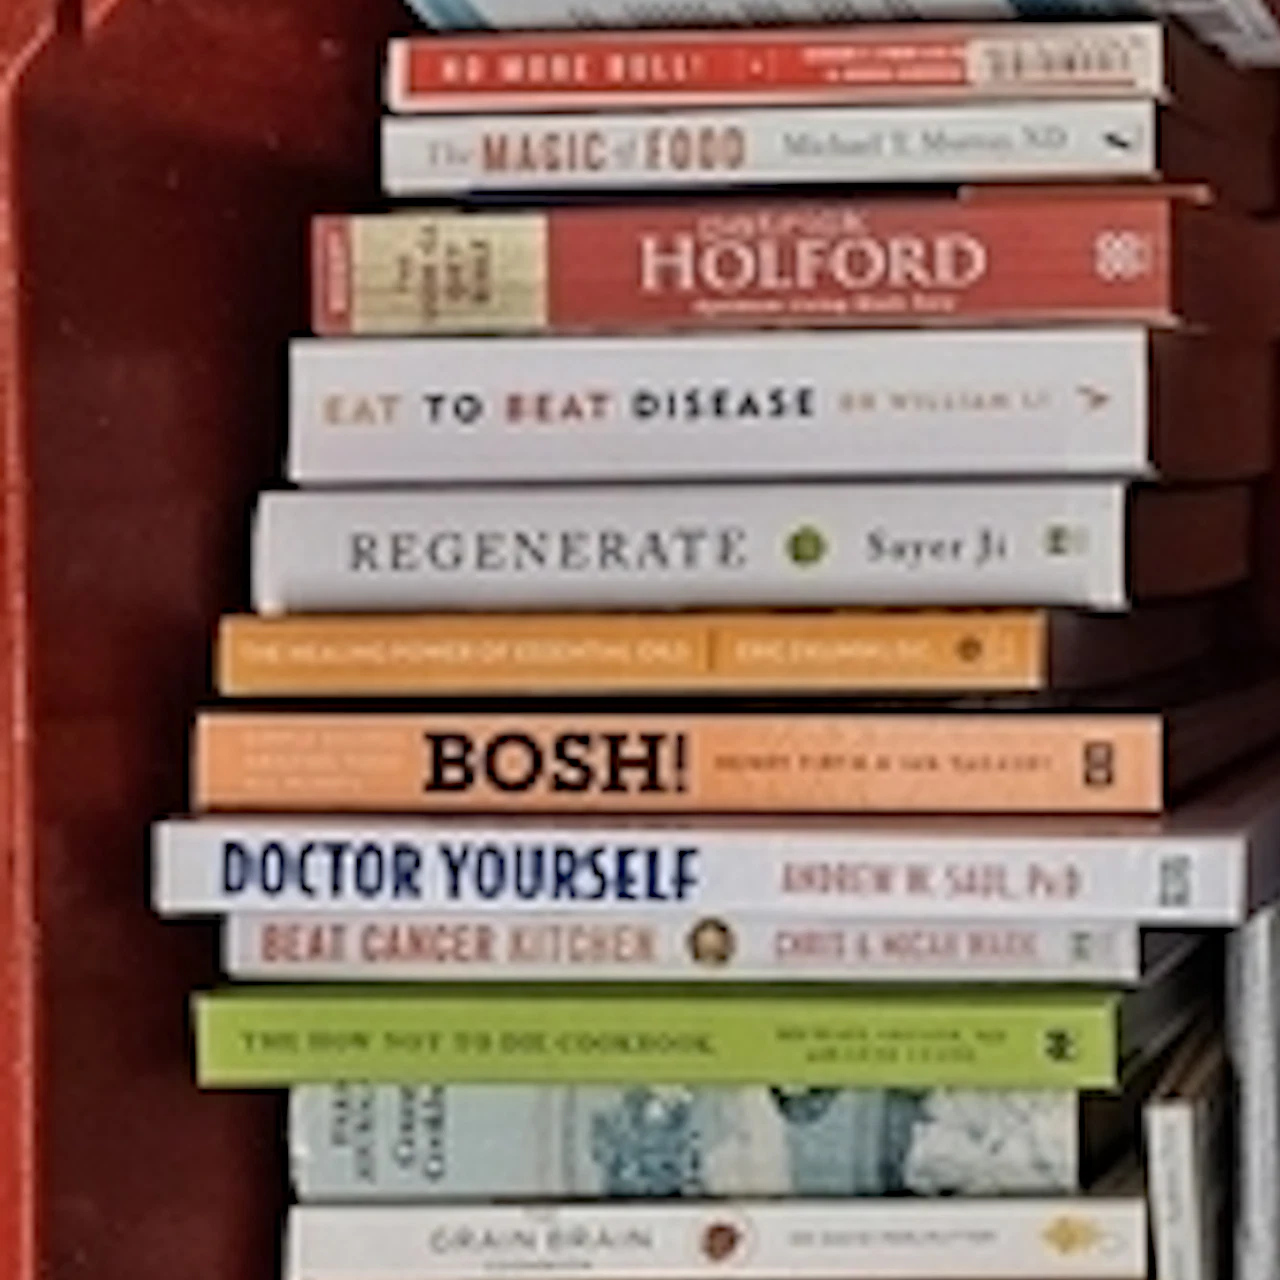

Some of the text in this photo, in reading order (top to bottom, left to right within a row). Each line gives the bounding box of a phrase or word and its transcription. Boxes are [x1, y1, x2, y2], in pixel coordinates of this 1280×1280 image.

[481, 132, 606, 172] MAGIC
[645, 126, 748, 169] FOOD
[639, 232, 989, 295] HOLFORD
[321, 394, 399, 426] EAT
[423, 393, 484, 426] TO
[504, 391, 609, 423] BEAT
[632, 387, 818, 422] DISEASE
[348, 527, 1007, 573] REGENERATE Sayer Ji
[423, 732, 690, 795] BOSH!
[220, 841, 423, 900] DOCTOR
[442, 846, 703, 902] YOURSELF
[782, 864, 897, 898] ANDREW
[259, 926, 348, 964] BEAT
[359, 926, 496, 964] CANCER
[506, 926, 657, 964] KITCHEN
[239, 1029, 299, 1056] THE
[429, 1225, 655, 1258] GRAIN BRAIN
